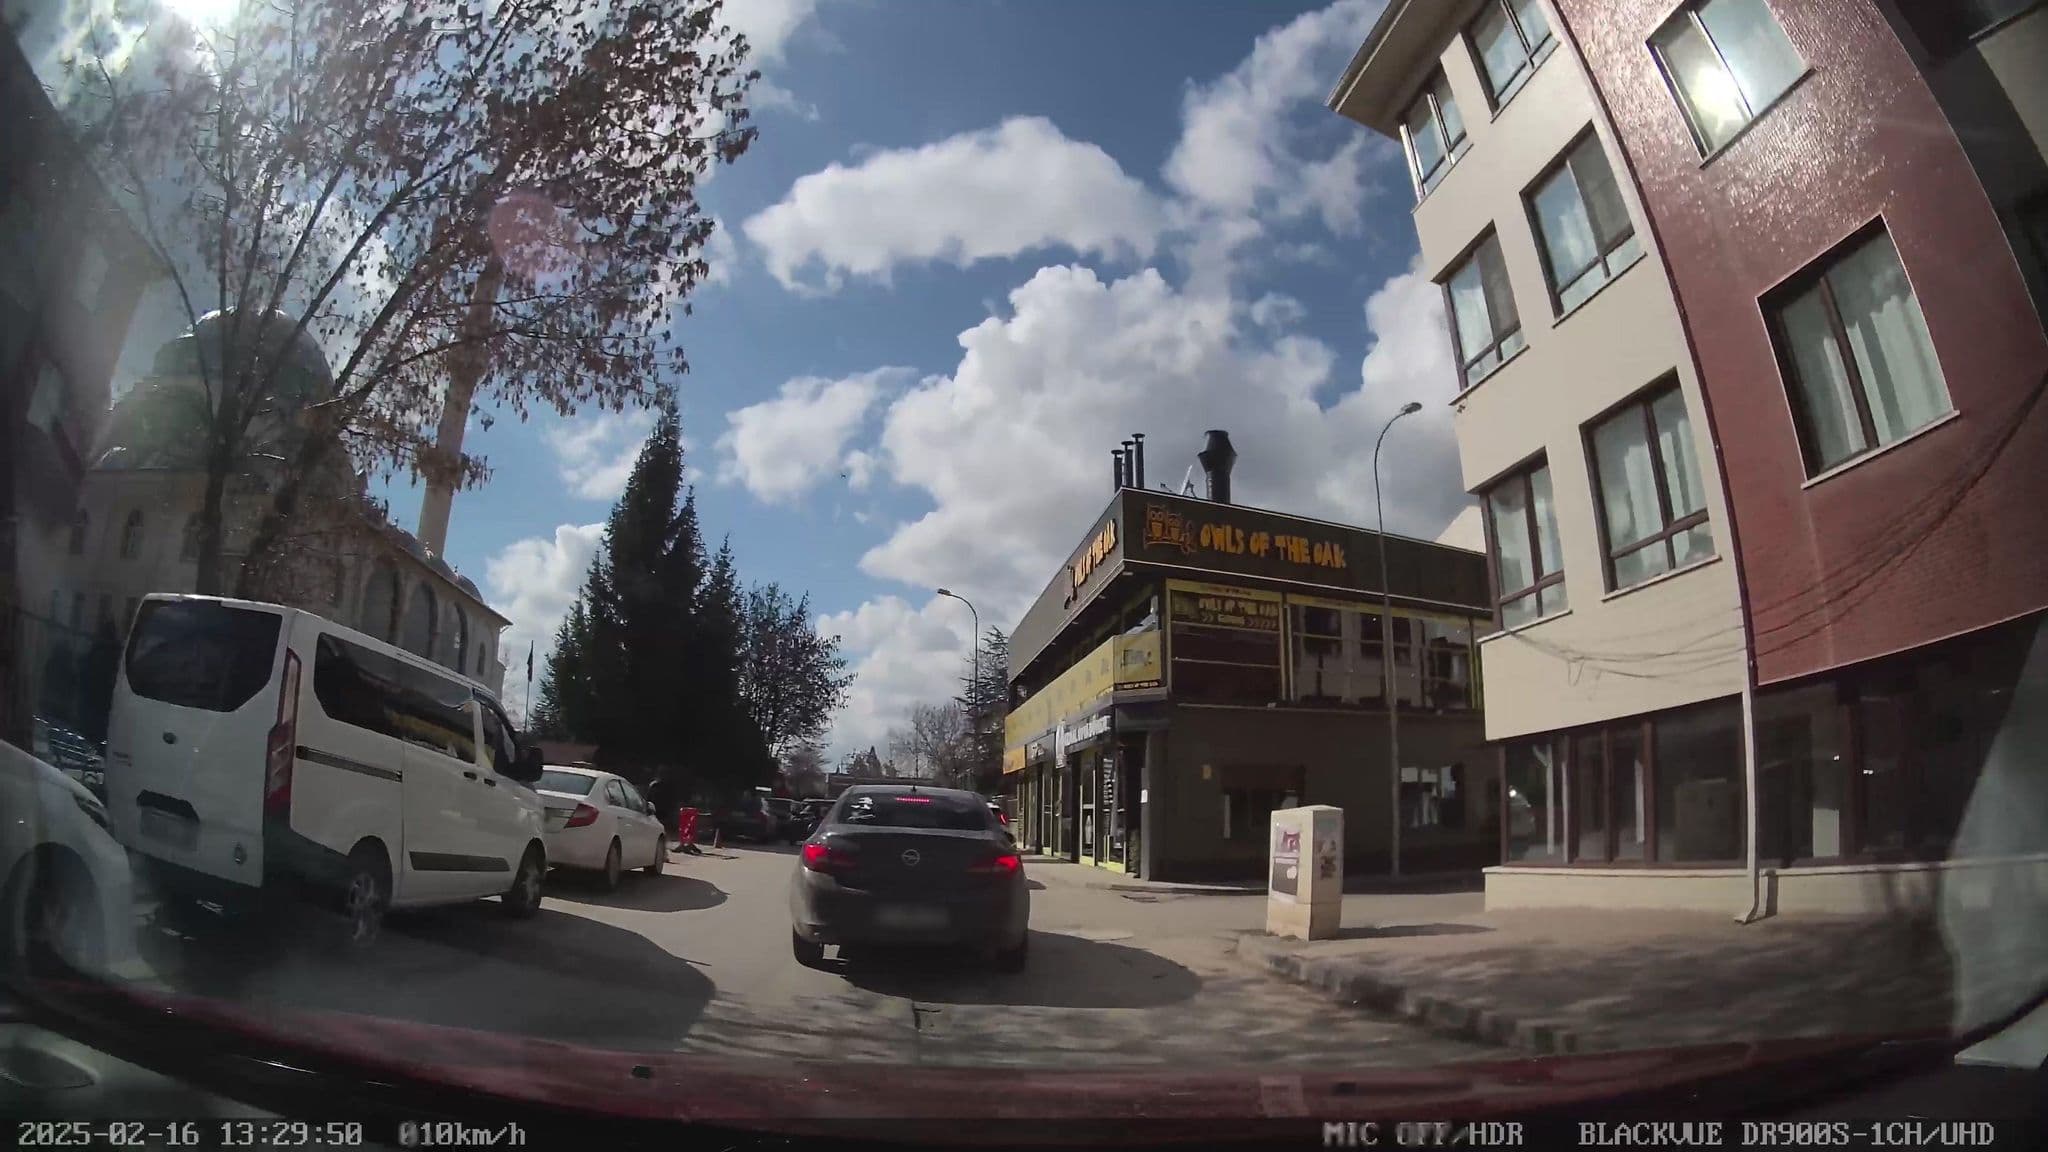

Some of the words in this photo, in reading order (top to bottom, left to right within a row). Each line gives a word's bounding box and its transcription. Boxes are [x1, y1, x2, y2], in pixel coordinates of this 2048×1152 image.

[1200, 523, 1245, 554] OWLS
[1250, 531, 1269, 557] OF
[1274, 534, 1311, 564] THE
[1313, 541, 1347, 568] OAK
